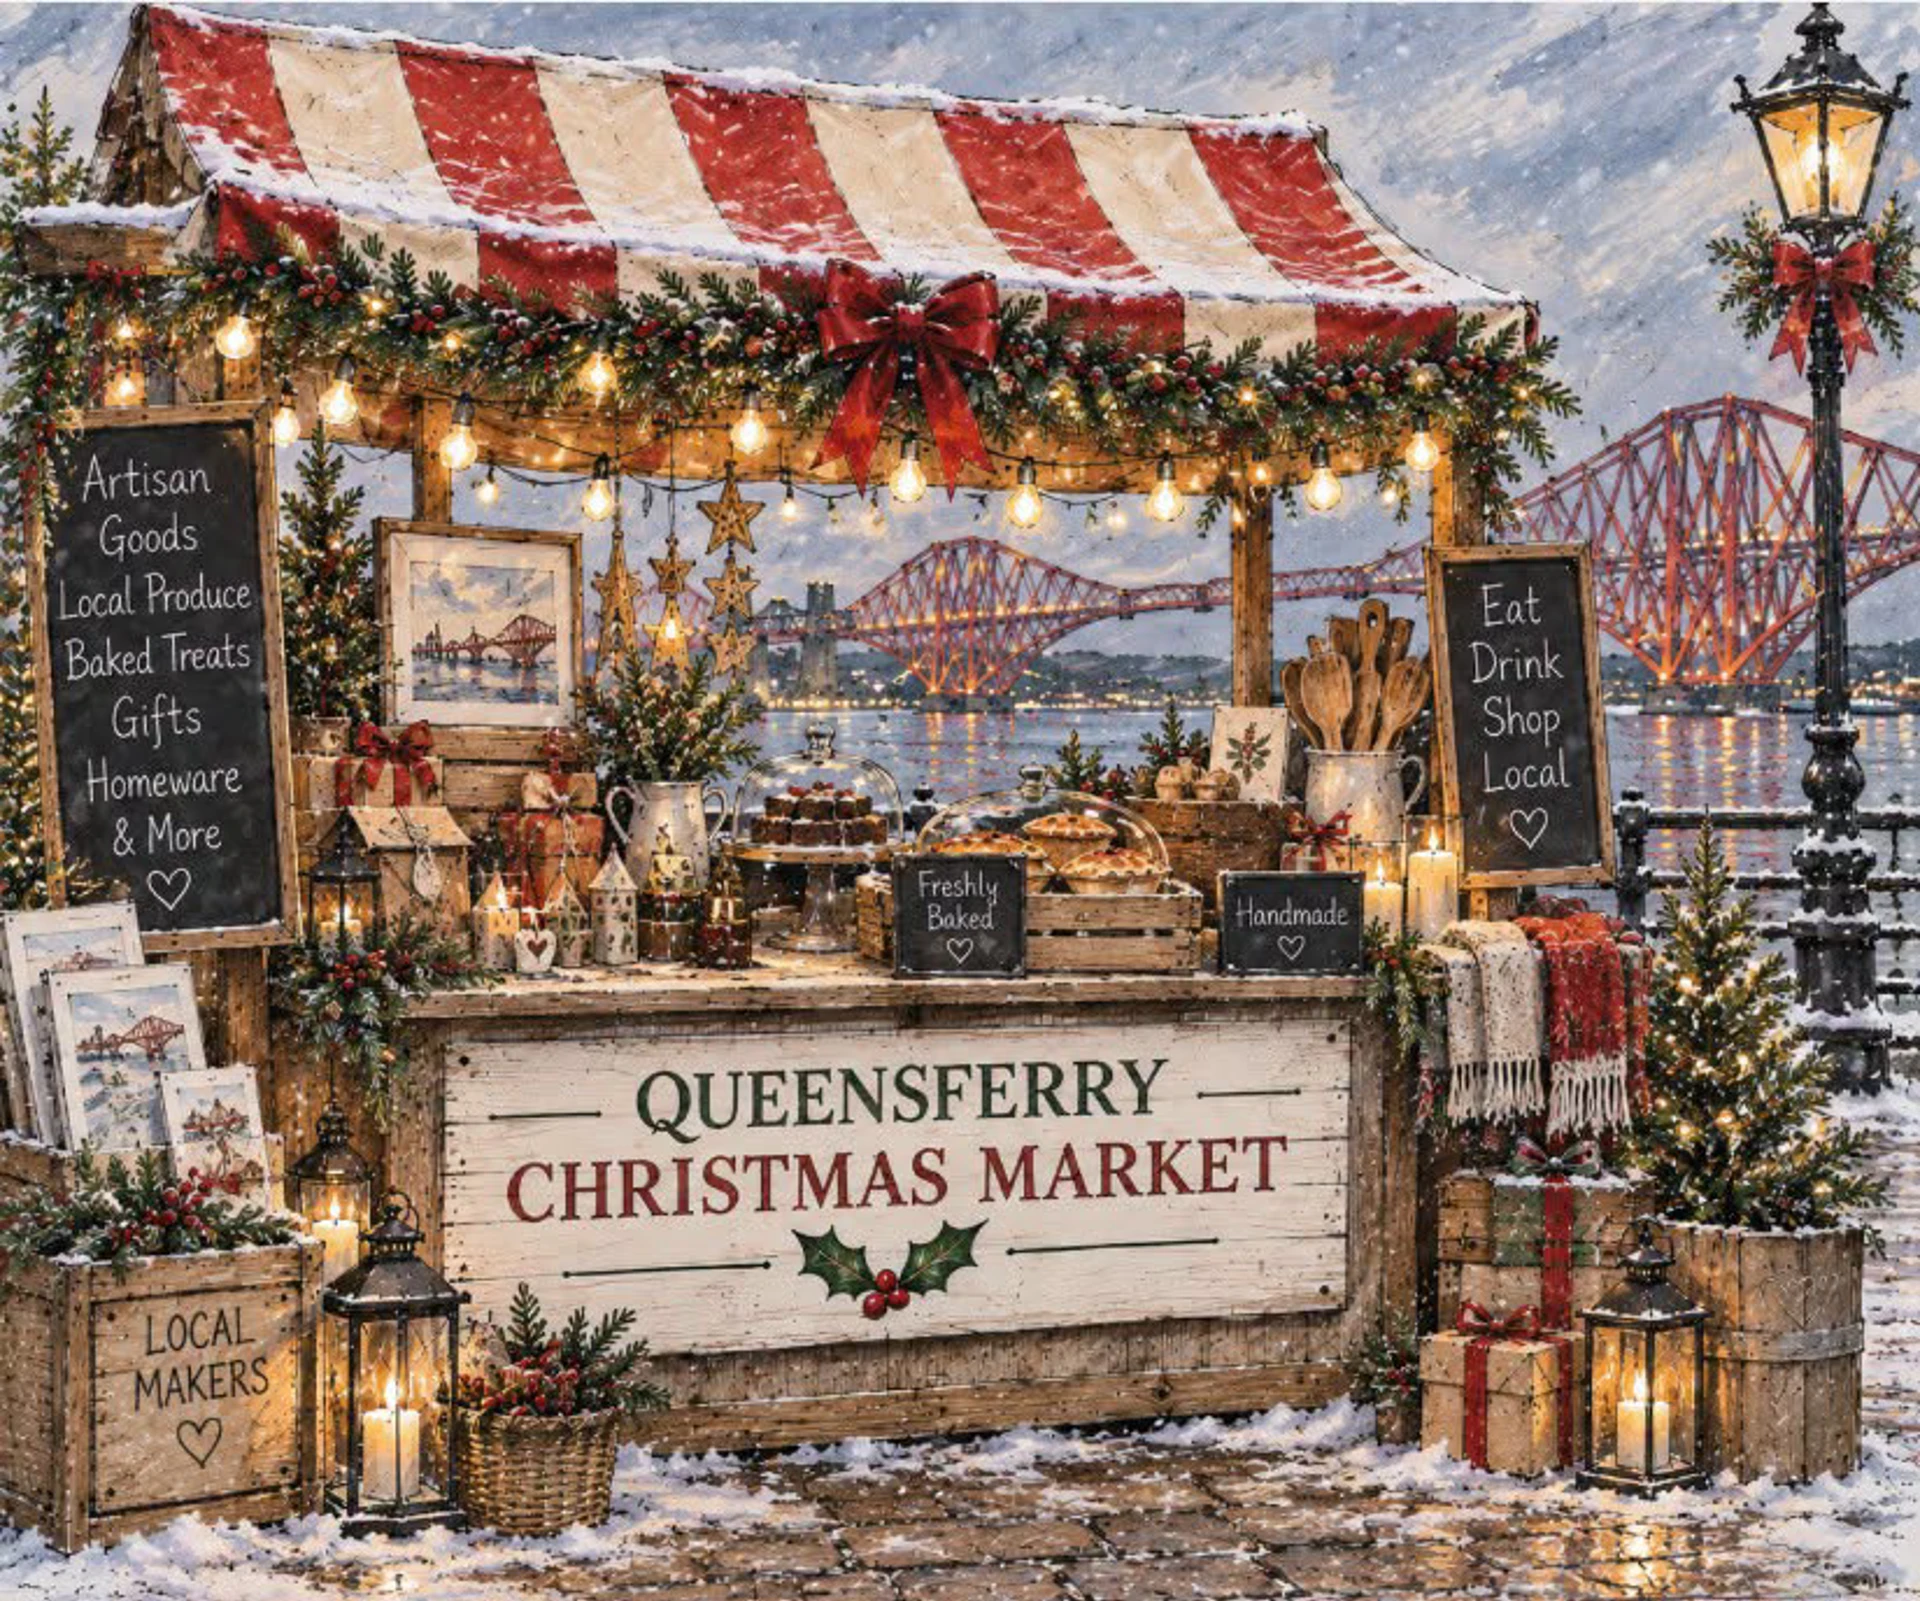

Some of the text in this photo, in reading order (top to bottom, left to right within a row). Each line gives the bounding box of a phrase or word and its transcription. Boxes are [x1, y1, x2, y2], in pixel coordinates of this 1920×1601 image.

[82, 454, 212, 502] Artisan
[99, 514, 199, 562] Goods
[59, 572, 252, 620] Local Produce
[1481, 583, 1542, 627] Eat
[65, 631, 251, 682] Baked Treats
[1468, 638, 1564, 683] Drink
[111, 695, 201, 749] Gifts
[1483, 695, 1560, 747] Shop
[86, 757, 243, 802] Homeware
[1483, 746, 1572, 793] Local
[113, 812, 222, 856] & More
[918, 869, 999, 905] Freshly
[927, 901, 995, 932] Baked
[1235, 896, 1349, 927] Handmade
[635, 1057, 1170, 1144] QUEENSFERRY
[506, 1135, 1289, 1225] CHRISTMAS MARKET
[145, 1306, 256, 1356] LOCAL
[134, 1356, 270, 1412] MAKERS
